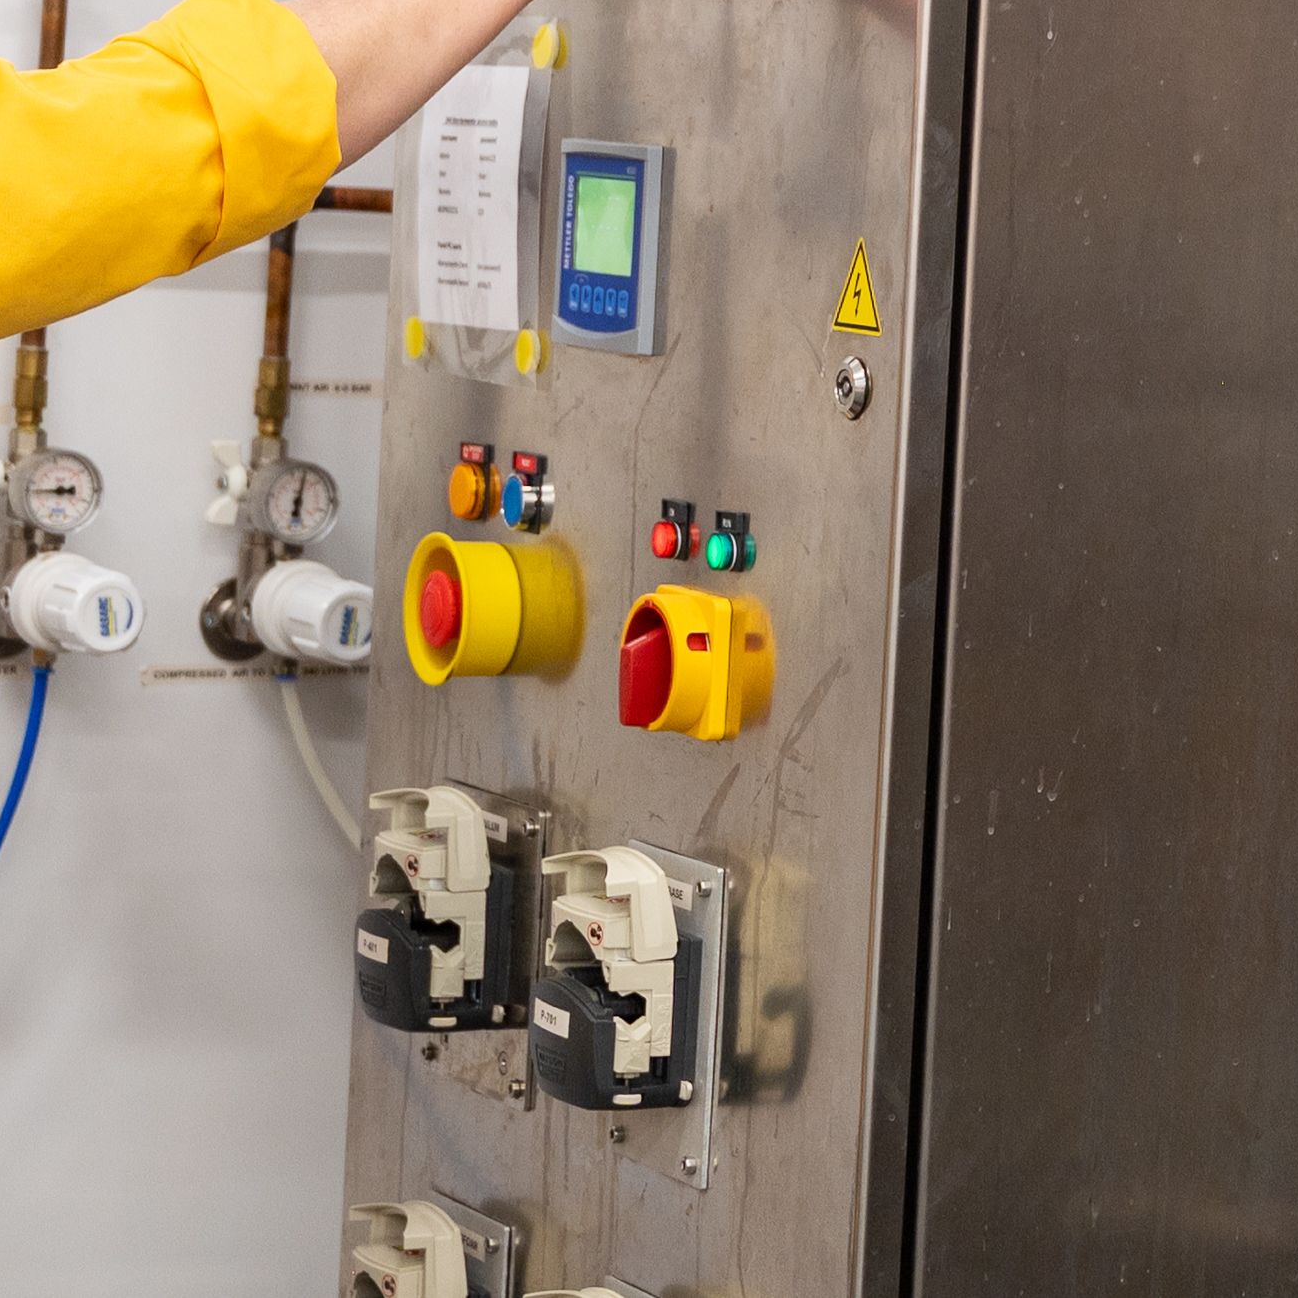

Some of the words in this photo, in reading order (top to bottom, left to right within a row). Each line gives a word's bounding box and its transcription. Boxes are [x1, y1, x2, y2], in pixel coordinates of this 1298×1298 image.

[566, 175, 575, 217] TOLEDO
[563, 220, 572, 269] METTLER
[153, 670, 227, 679] COMPRESSED
